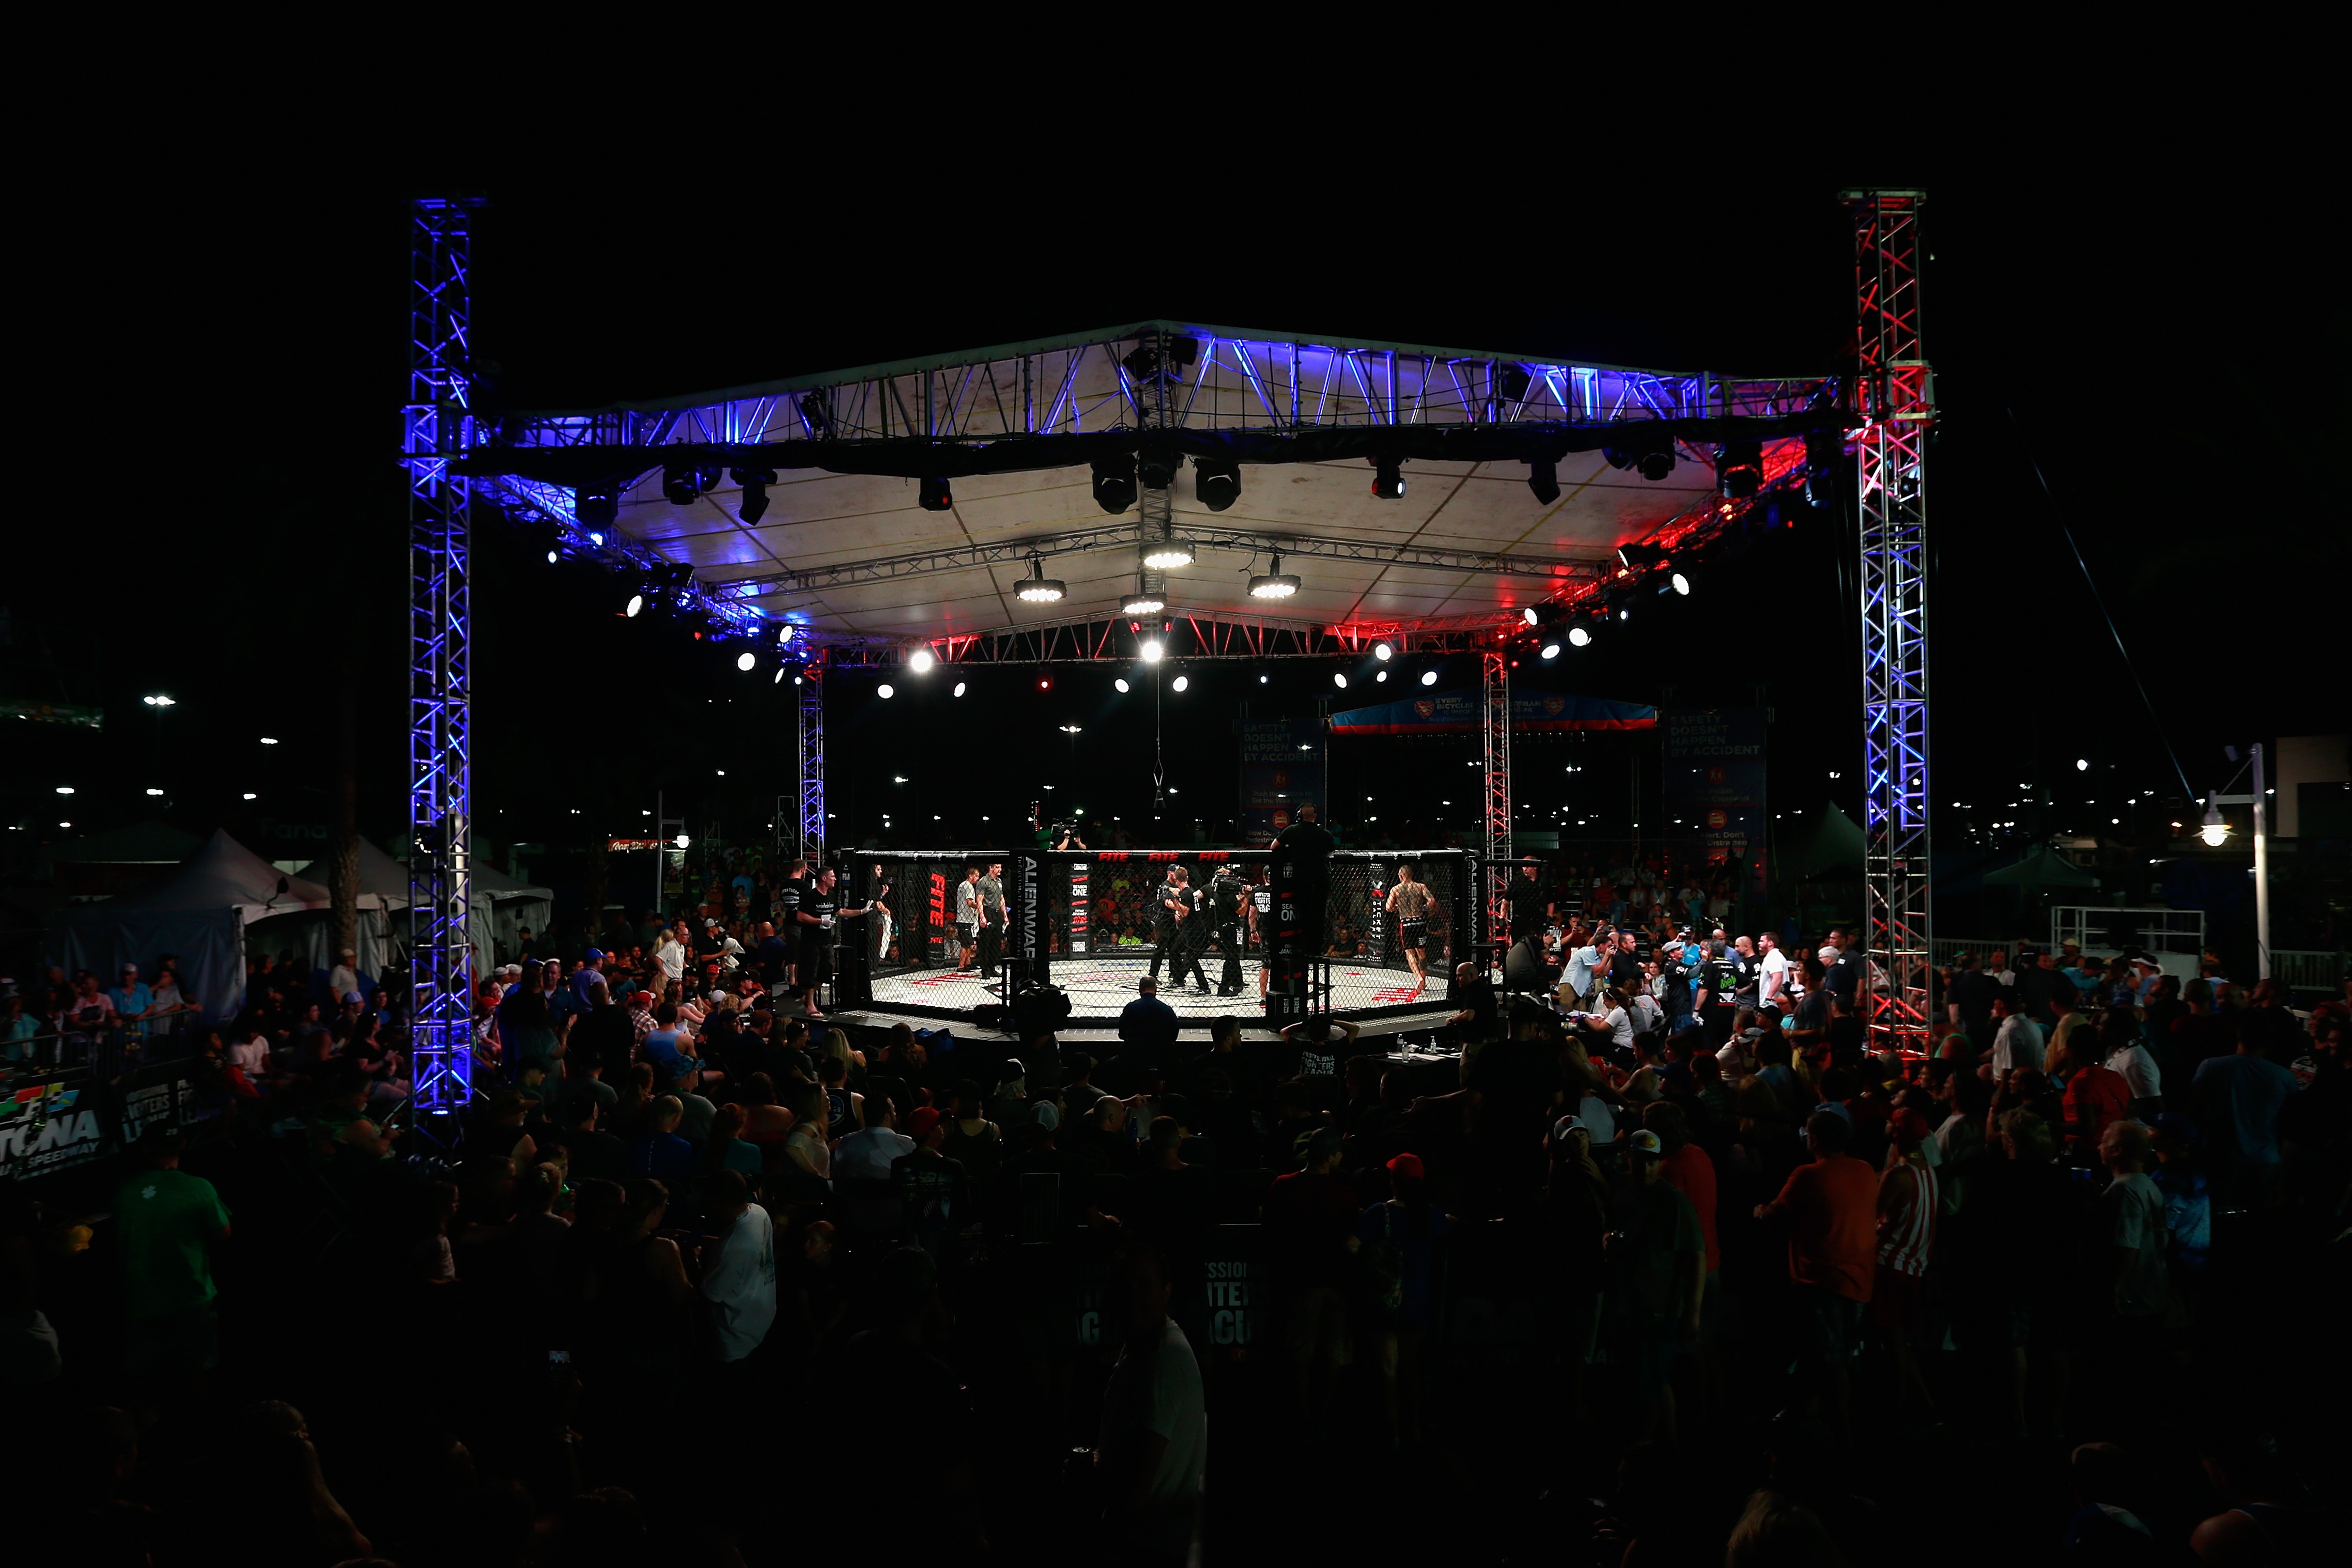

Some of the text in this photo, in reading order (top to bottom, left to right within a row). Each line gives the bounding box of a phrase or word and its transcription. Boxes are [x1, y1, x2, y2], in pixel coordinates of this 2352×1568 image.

[1670, 715, 1721, 725] SAFETY
[1243, 723, 1287, 733] SAFETY
[1670, 724, 1729, 736] DOESN'T
[1244, 733, 1292, 742] DOESN'T
[1671, 735, 1726, 745] HAPPEN
[1244, 742, 1289, 752] HAPPEN
[1670, 745, 1760, 757] BY ACCIDENT
[1244, 752, 1319, 762] BY ACCIDENT
[1097, 852, 1129, 862] FITE
[1148, 852, 1179, 862] FITE
[1198, 852, 1229, 862] FITE
[930, 873, 946, 928] FITE
[1301, 1056, 1335, 1070] FIGHTERS
[27, 1140, 100, 1169] SPEEDWAY
